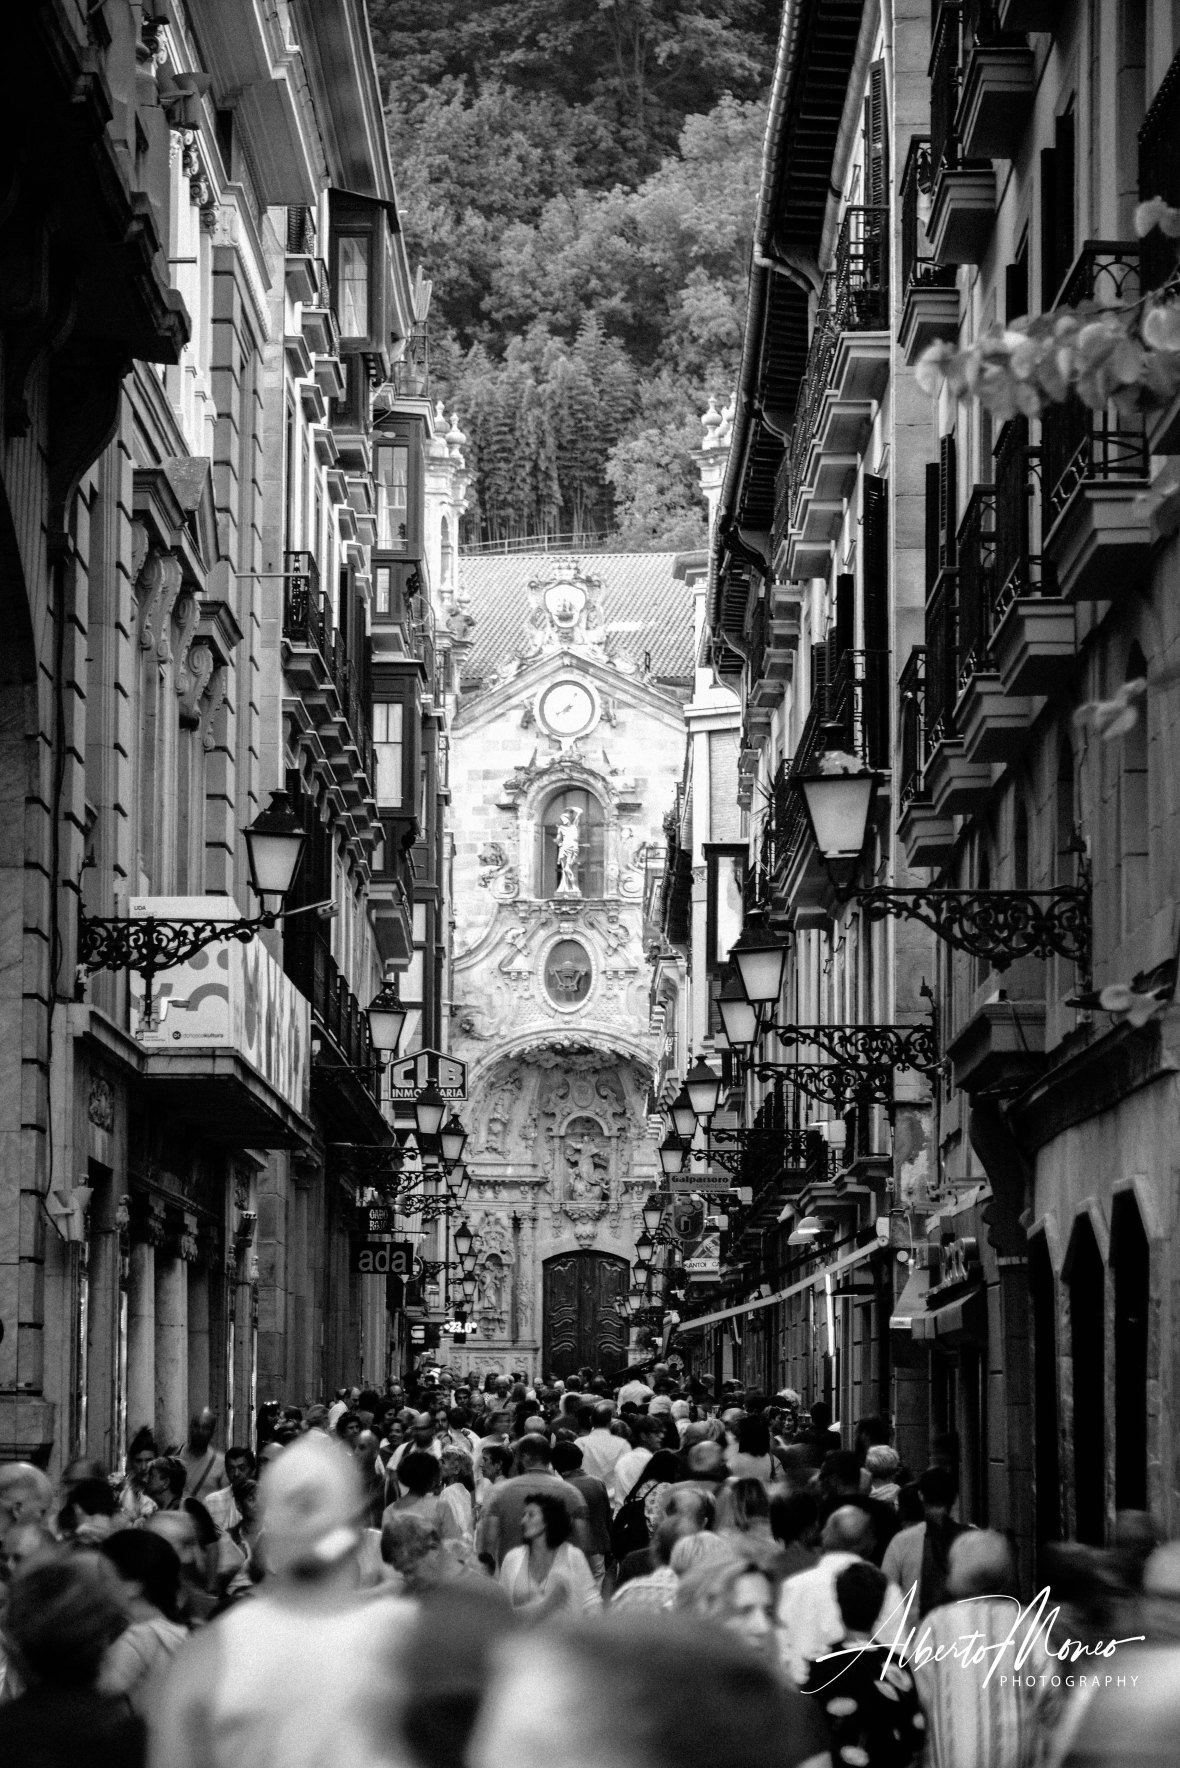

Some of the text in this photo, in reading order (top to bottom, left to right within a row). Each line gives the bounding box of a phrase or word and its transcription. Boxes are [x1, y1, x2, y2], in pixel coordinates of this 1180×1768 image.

[392, 1088, 464, 1098] INMOARIA
[671, 1175, 729, 1184] Galparsoro
[358, 1243, 407, 1273] ada
